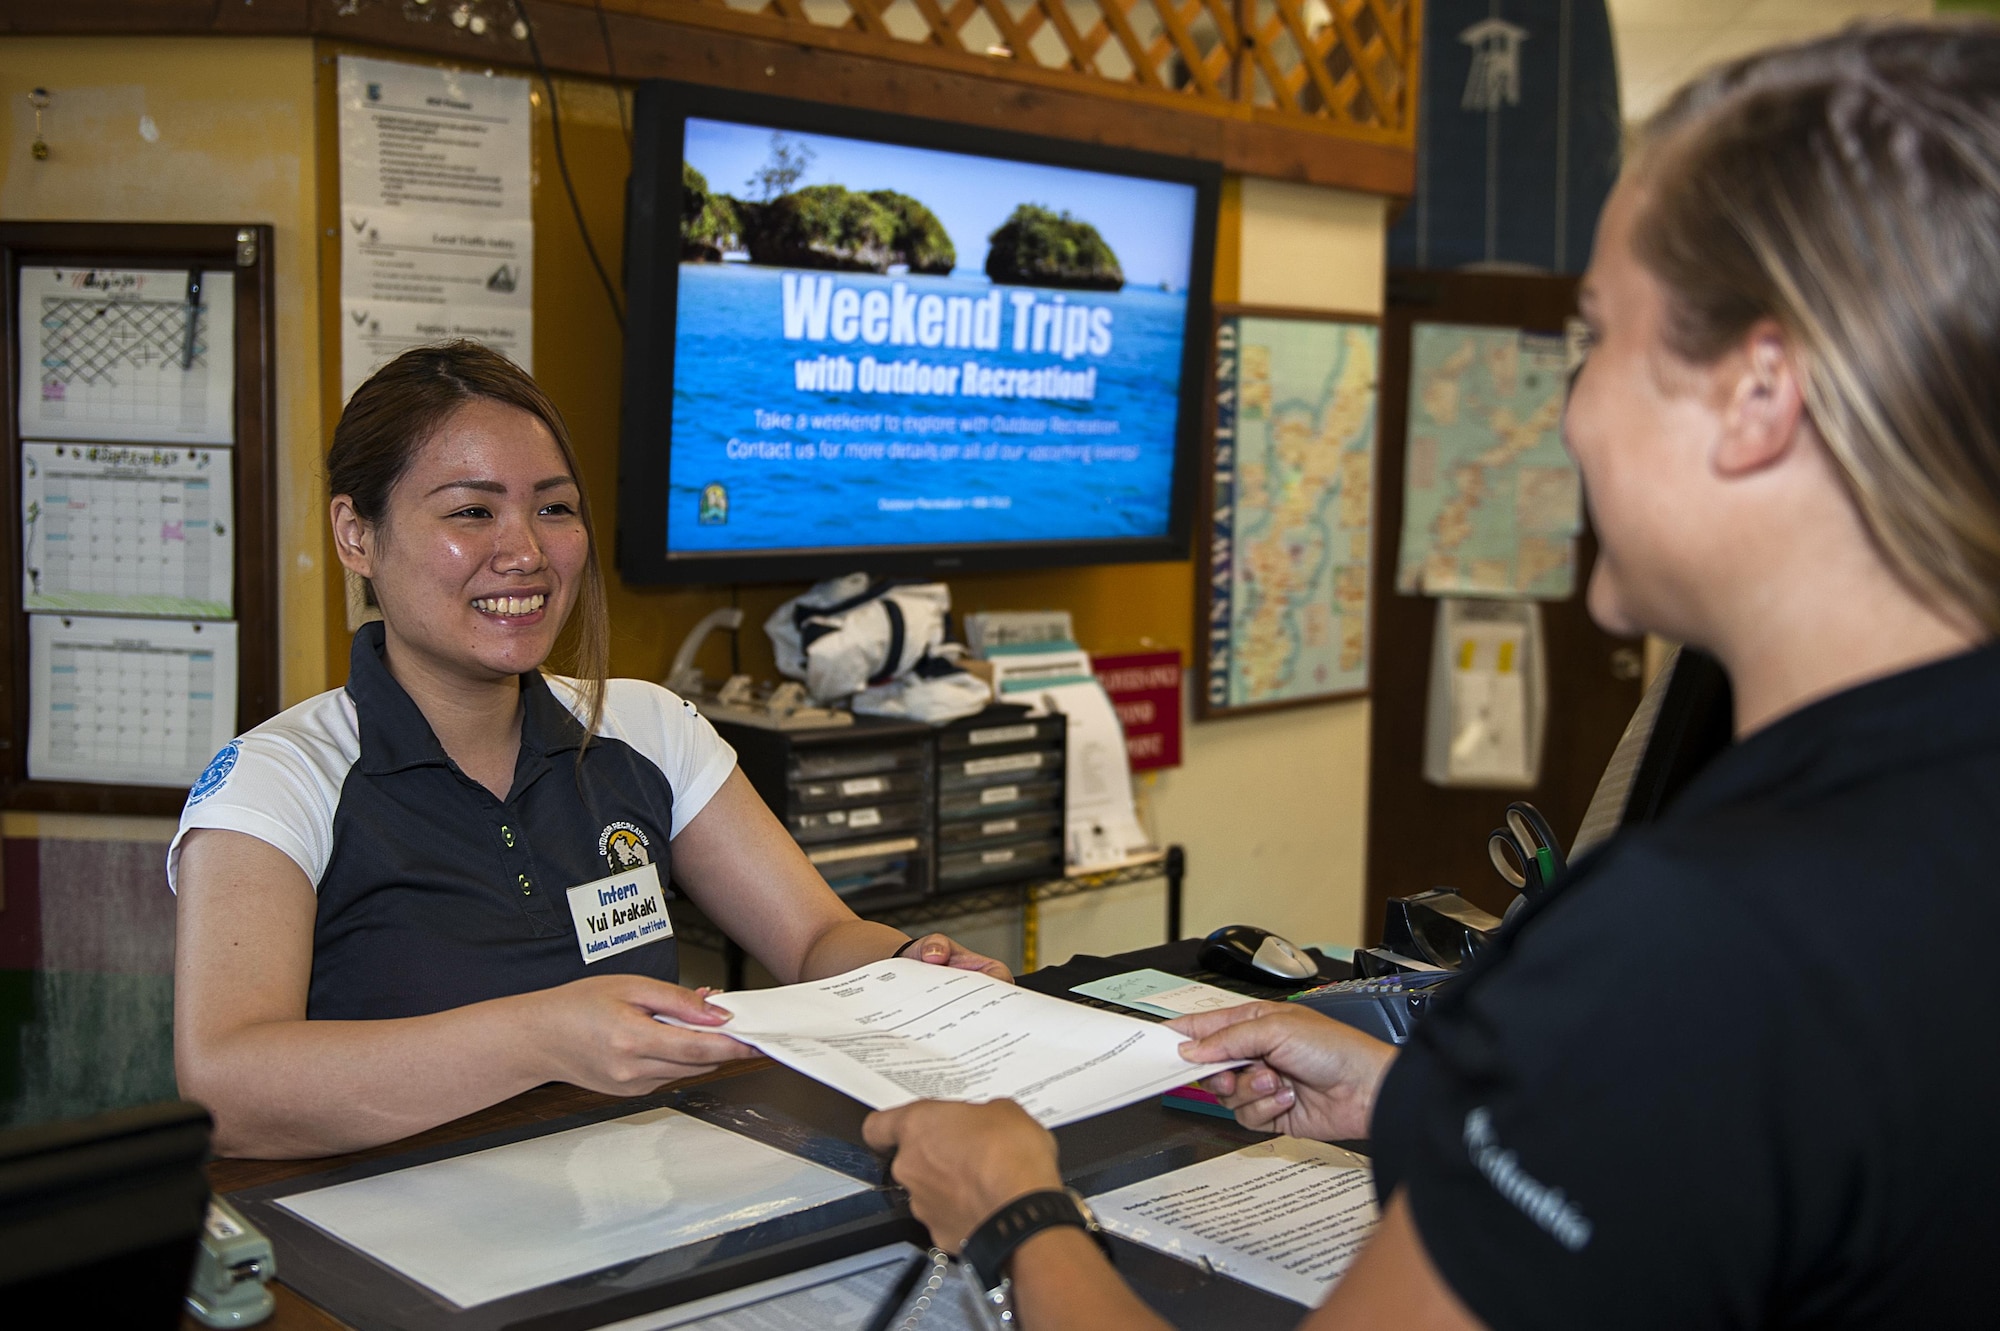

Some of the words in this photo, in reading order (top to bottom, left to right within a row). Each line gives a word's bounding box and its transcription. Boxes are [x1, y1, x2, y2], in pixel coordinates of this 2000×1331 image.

[782, 274, 1000, 351] Weekend
[1011, 290, 1112, 359] Trips
[795, 355, 853, 392] with
[857, 357, 958, 396] Outdoor
[961, 361, 1096, 400] Recreation!
[754, 409, 793, 431] Take
[795, 415, 808, 431] a
[810, 413, 882, 432] weekend
[884, 415, 900, 431] to
[902, 416, 957, 436] explore
[1214, 325, 1237, 483] ISLAND
[726, 438, 791, 460] Contact
[794, 445, 815, 461] us
[818, 440, 841, 461] for
[843, 444, 884, 461] more
[1208, 504, 1233, 704] OKINAWA
[599, 823, 613, 856] OUTDOOR
[611, 821, 650, 847] RECREATION
[597, 883, 639, 907] Intern
[586, 912, 609, 935] Yui
[612, 896, 658, 927] Arakaki
[586, 939, 611, 955] Kadena,
[609, 930, 639, 947] Language,
[638, 919, 667, 937] Institute
